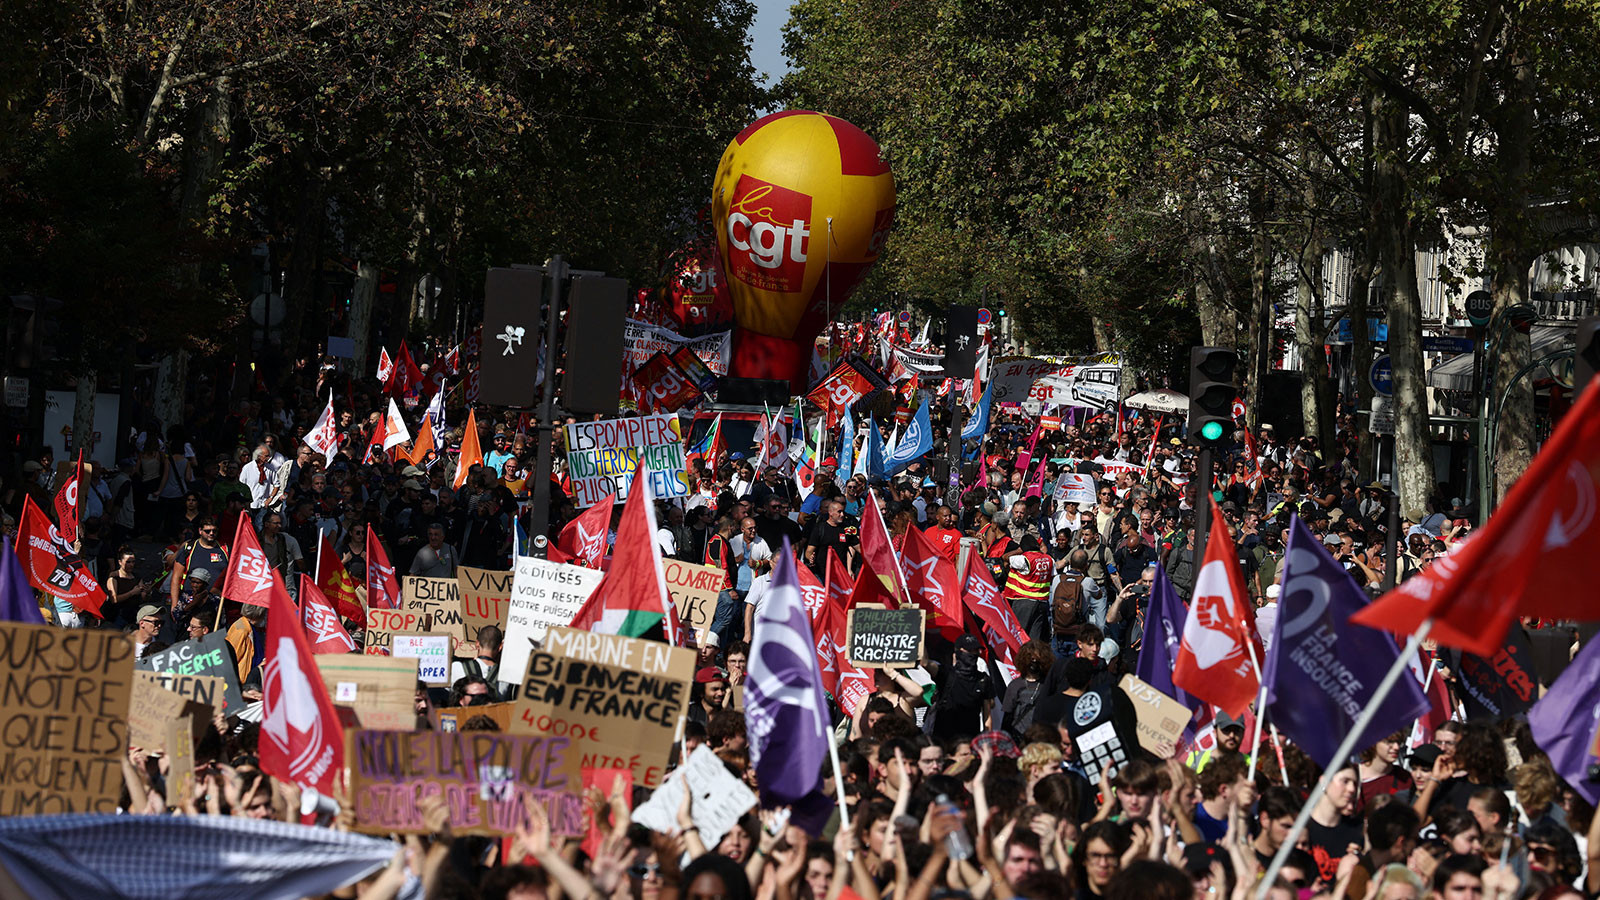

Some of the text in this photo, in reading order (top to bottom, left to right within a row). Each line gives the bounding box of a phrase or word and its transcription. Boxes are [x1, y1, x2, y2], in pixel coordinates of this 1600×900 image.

[727, 212, 810, 269] cgt
[690, 306, 707, 318] 91
[1469, 300, 1491, 311] BUS
[636, 340, 672, 352] CLASSES
[651, 366, 686, 399] cgt
[1006, 365, 1023, 376] EN
[1028, 385, 1054, 401] cgt
[595, 417, 679, 448] POMPIERS
[51, 568, 71, 588] 75
[1036, 561, 1050, 571] CGT
[518, 585, 586, 606] VOUS RESTE
[966, 575, 996, 604] FSE
[304, 605, 337, 633] FSE
[368, 610, 415, 631] STOP
[465, 594, 511, 621] LUT
[1315, 624, 1338, 648] LA
[152, 646, 193, 672] FAC
[546, 628, 633, 669] MARINE
[644, 644, 671, 673] EN
[418, 667, 445, 678] APPER
[1301, 634, 1364, 695] FRANCE
[3, 672, 122, 719] NOTRE
[524, 679, 680, 729] EN FRANCE
[1126, 676, 1161, 709] VISA
[3, 714, 122, 755] QUE LES
